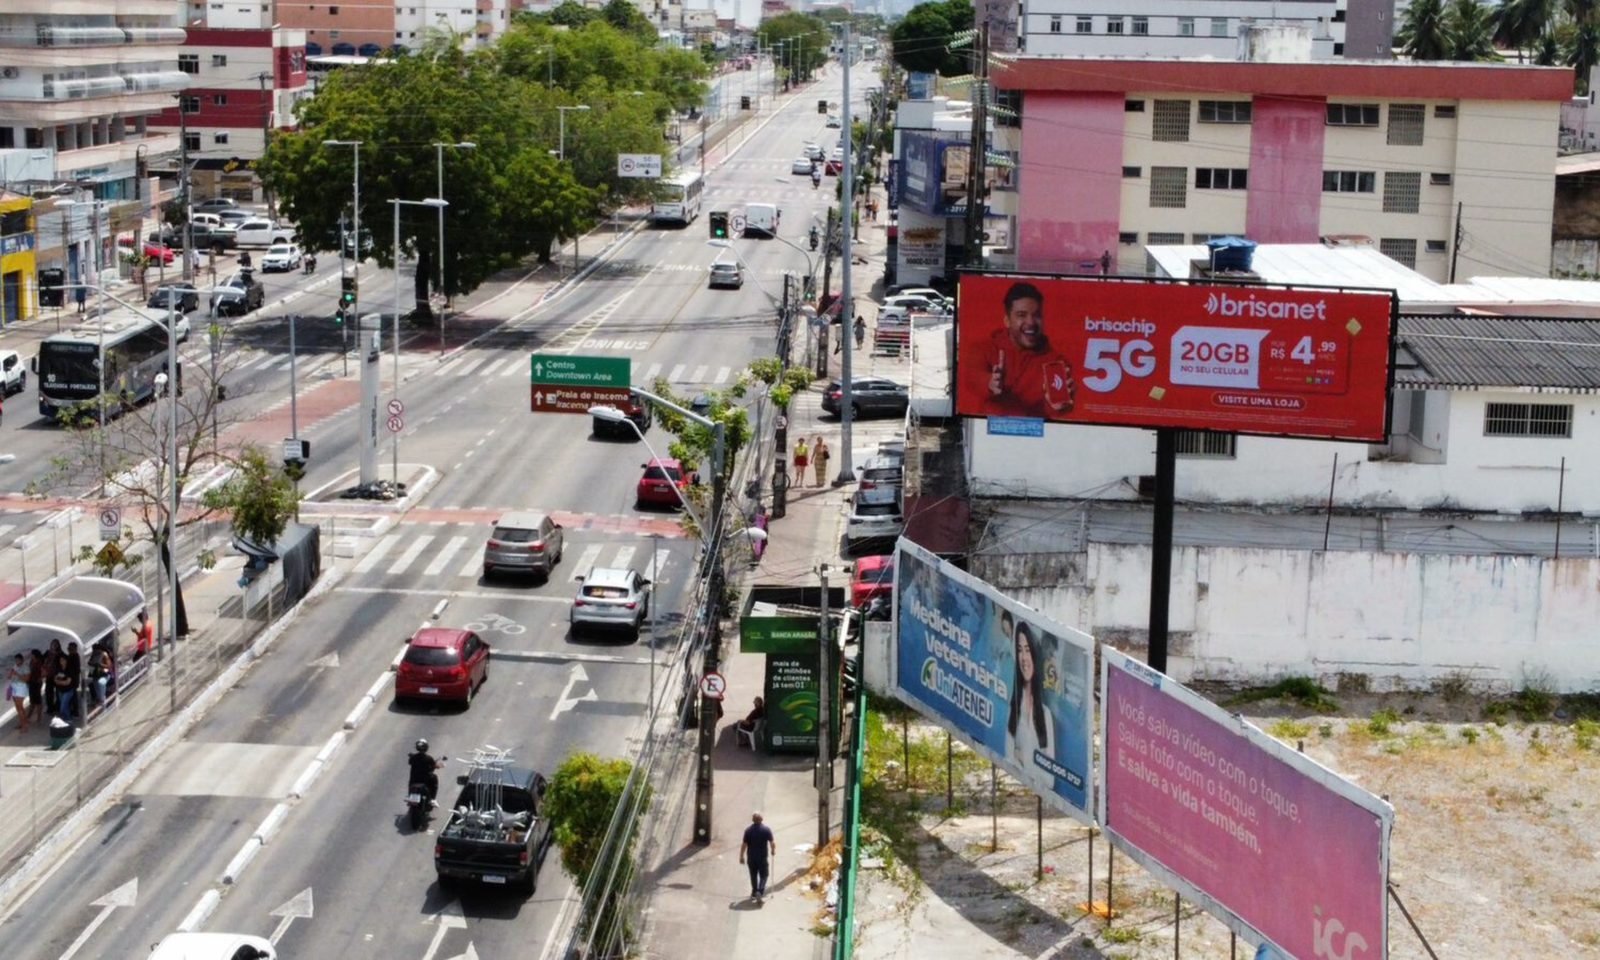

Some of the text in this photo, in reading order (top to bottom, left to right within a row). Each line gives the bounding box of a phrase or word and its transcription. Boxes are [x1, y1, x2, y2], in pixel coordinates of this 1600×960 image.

[1221, 292, 1327, 321] brisanet
[1085, 316, 1156, 337] brisachip
[1180, 341, 1250, 364] 20GB
[1270, 348, 1286, 360] R$
[1290, 335, 1316, 365] 4
[546, 360, 576, 370] Centro
[546, 371, 613, 381] Downtown Area
[1082, 338, 1156, 393] 5G
[1180, 365, 1249, 376] NO SEU CELULAR
[556, 390, 629, 401] Praia de Iracema
[556, 400, 589, 409] Iracema
[1218, 395, 1300, 408] VISITE UMA LOJA
[910, 596, 971, 650] Medicina
[770, 631, 791, 639] BANCA
[784, 667, 812, 675] milhões
[924, 630, 1008, 700] Veterinária
[1118, 695, 1302, 823] Você salva vídeo com o toque.
[1118, 722, 1259, 825] Salva foto com o toque.
[1118, 748, 1126, 768] E
[1127, 758, 1159, 788] salva
[1161, 777, 1169, 794] a
[1170, 782, 1198, 813] vida
[1200, 799, 1262, 854] também.
